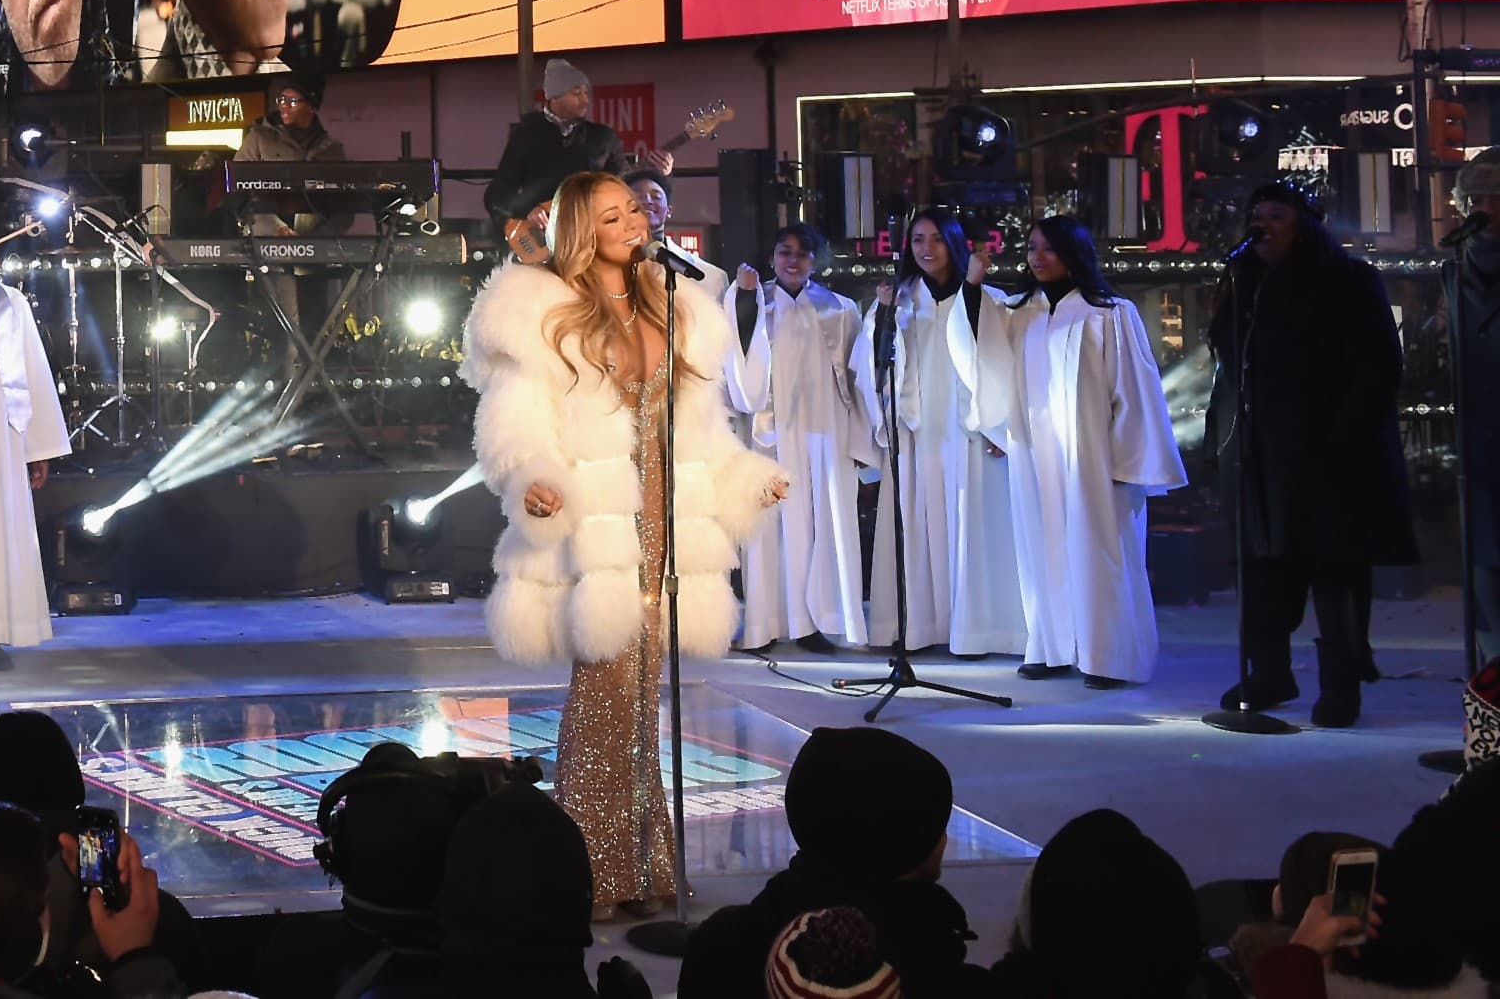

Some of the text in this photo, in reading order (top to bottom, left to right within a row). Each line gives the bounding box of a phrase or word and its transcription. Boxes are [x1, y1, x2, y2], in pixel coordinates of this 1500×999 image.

[841, 0, 881, 15] NETFLIX
[187, 97, 244, 124] INVICTA
[599, 97, 643, 131] UNI
[190, 244, 315, 257] KORG KRONOS
